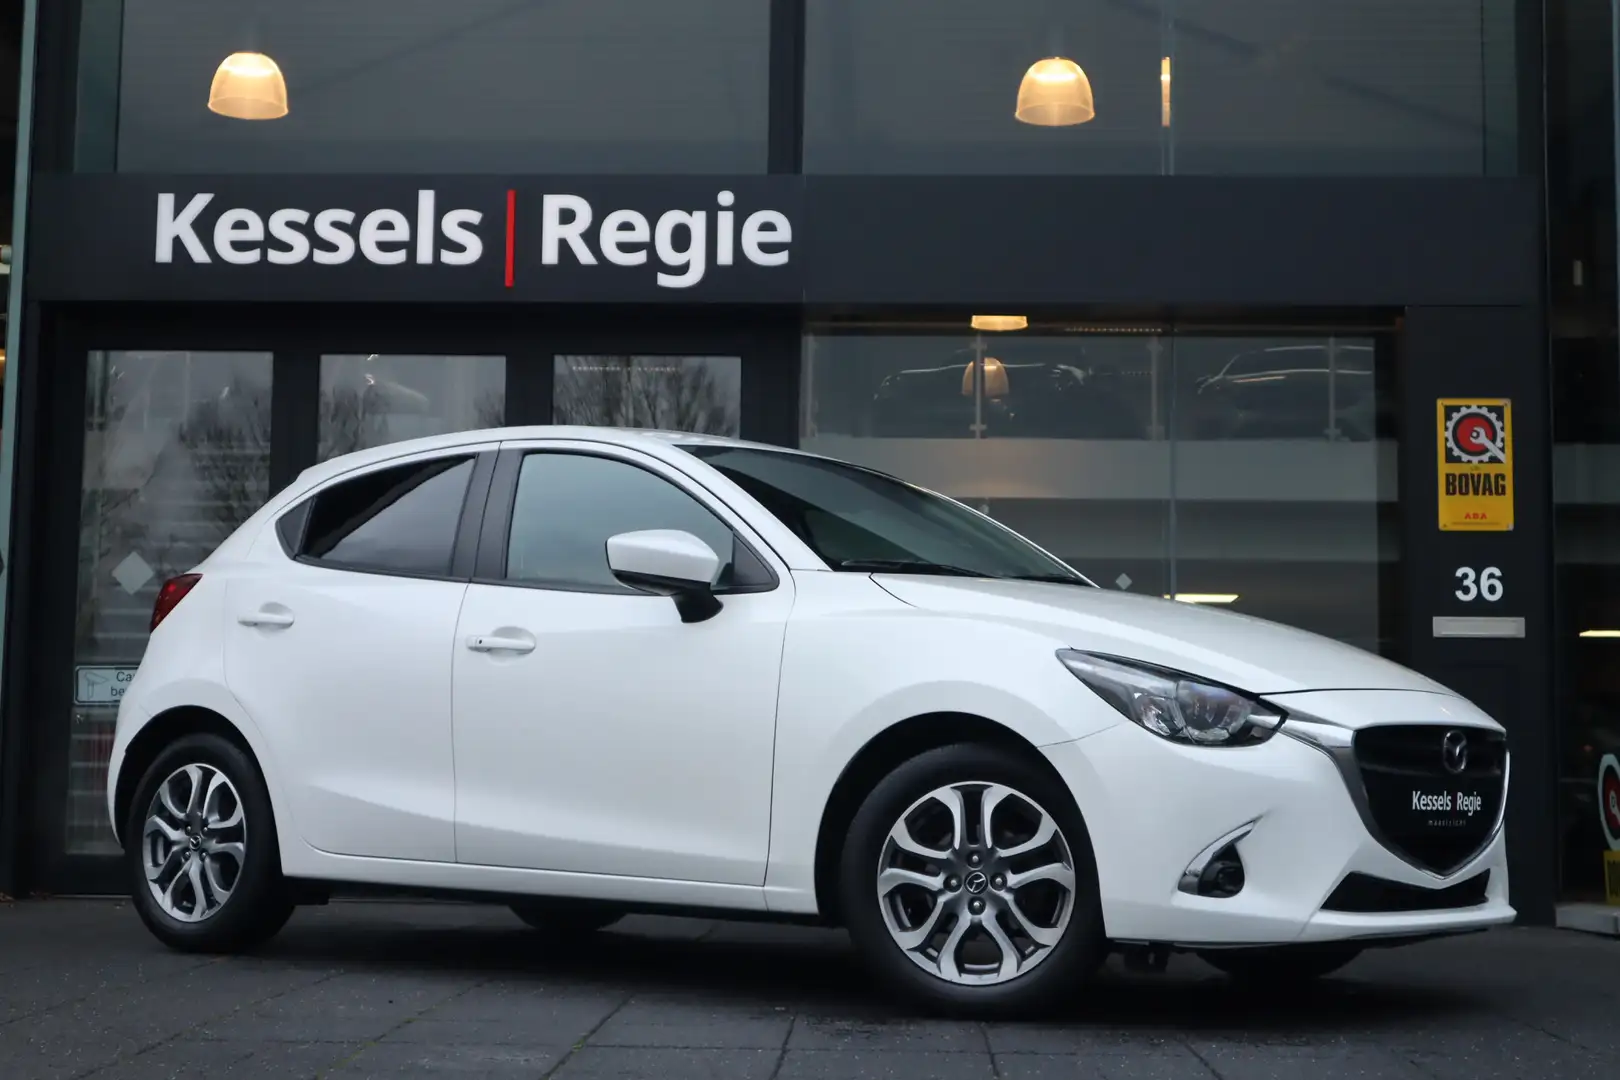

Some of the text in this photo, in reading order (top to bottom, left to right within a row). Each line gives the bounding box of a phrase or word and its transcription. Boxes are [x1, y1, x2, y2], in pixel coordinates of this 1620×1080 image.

[155, 189, 792, 288] Kessels Regie
[1445, 473, 1506, 496] BOVAG
[1455, 566, 1504, 602] 36
[116, 671, 135, 682] Ca
[110, 686, 126, 696] be
[1412, 790, 1482, 816] Kessels Regie
